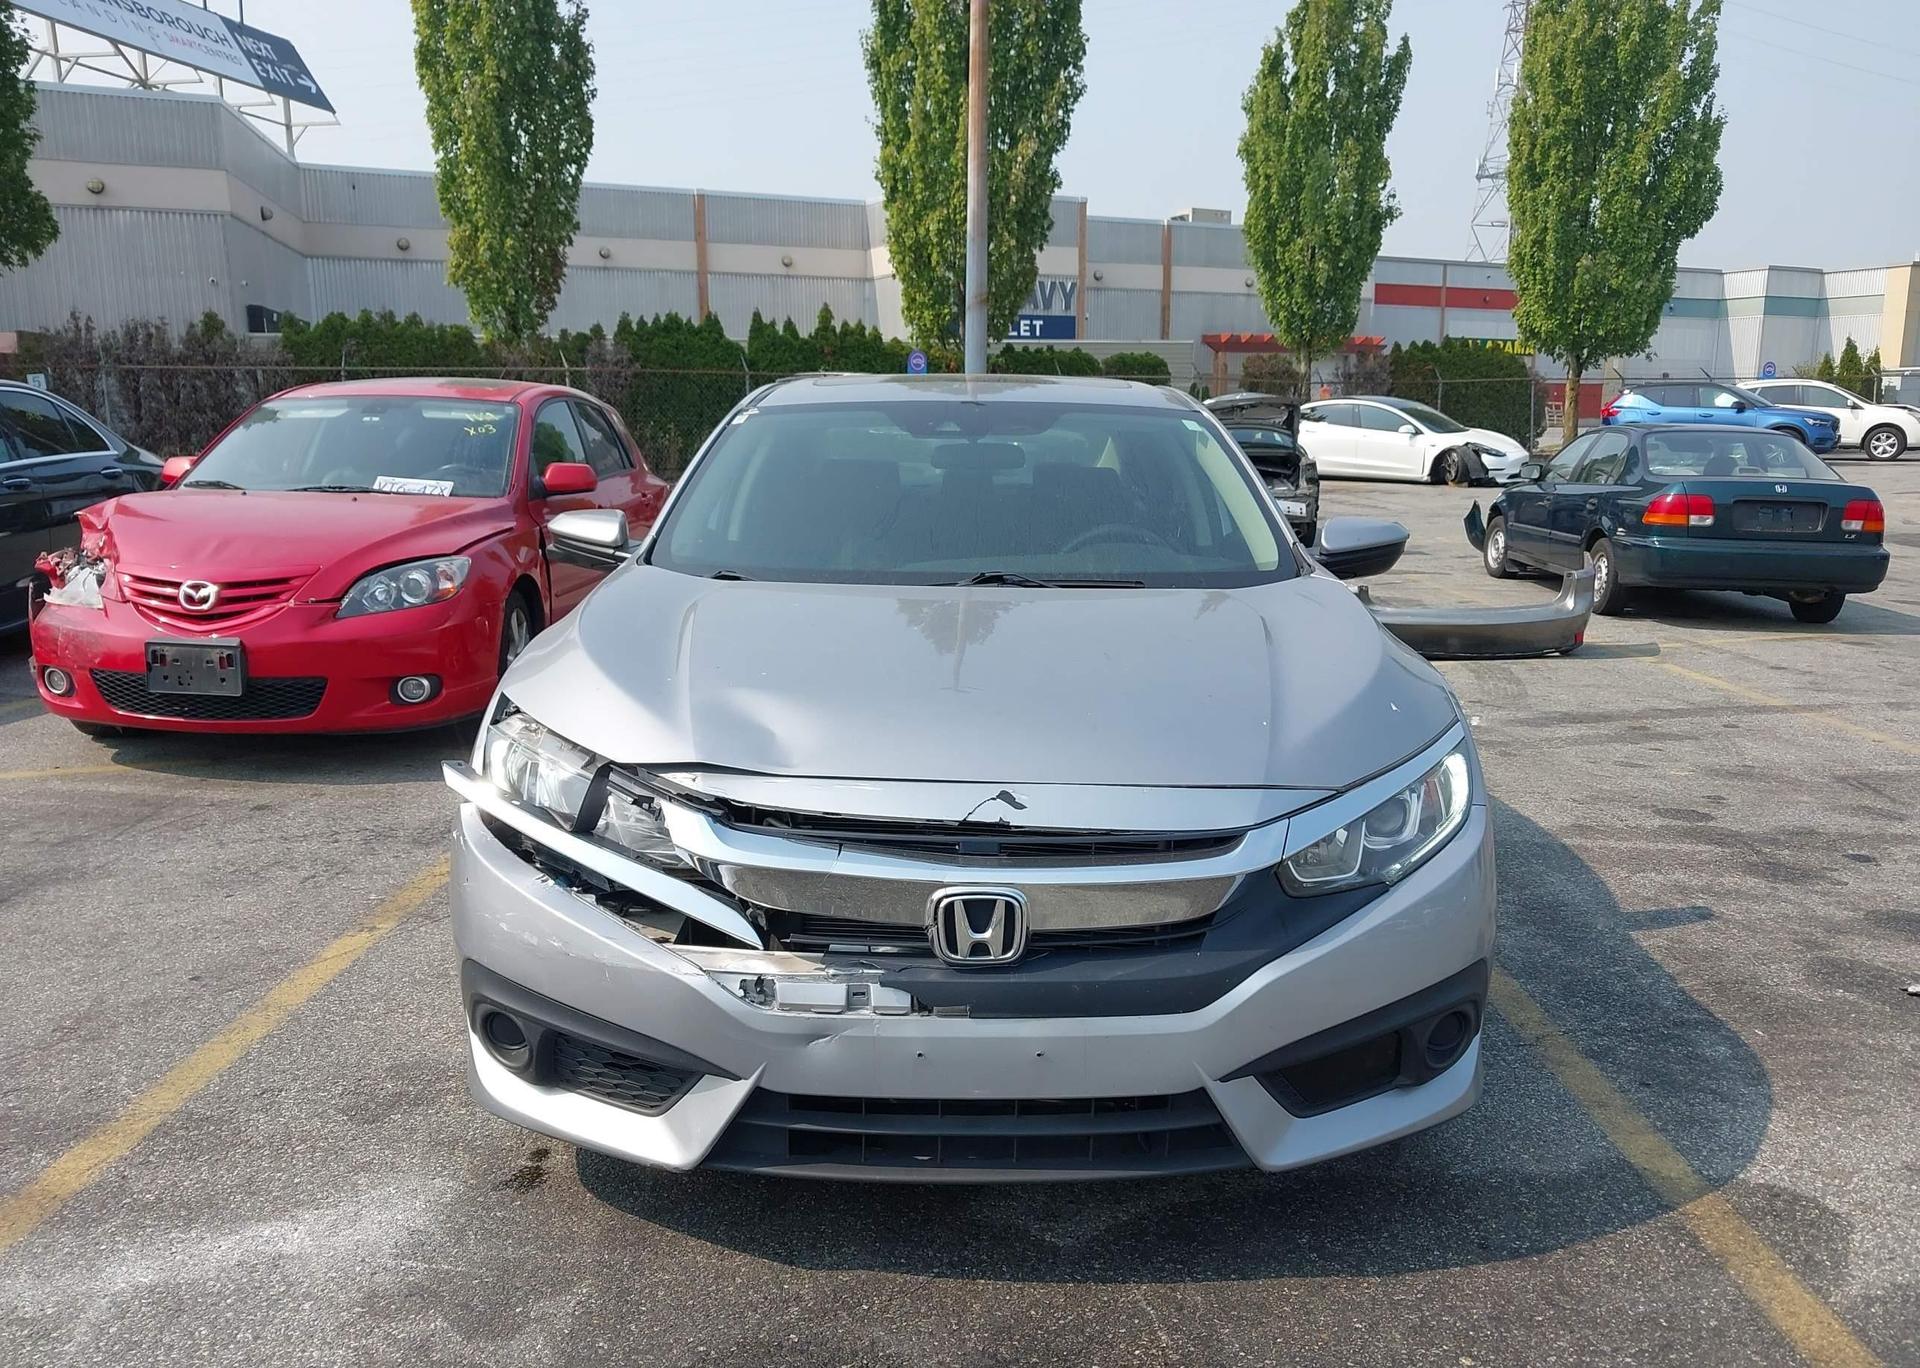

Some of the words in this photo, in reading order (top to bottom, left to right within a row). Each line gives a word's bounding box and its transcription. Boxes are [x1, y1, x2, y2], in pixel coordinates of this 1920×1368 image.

[234, 32, 278, 61] NEXT
[250, 58, 295, 87] EXIT
[1008, 319, 1043, 336] LET
